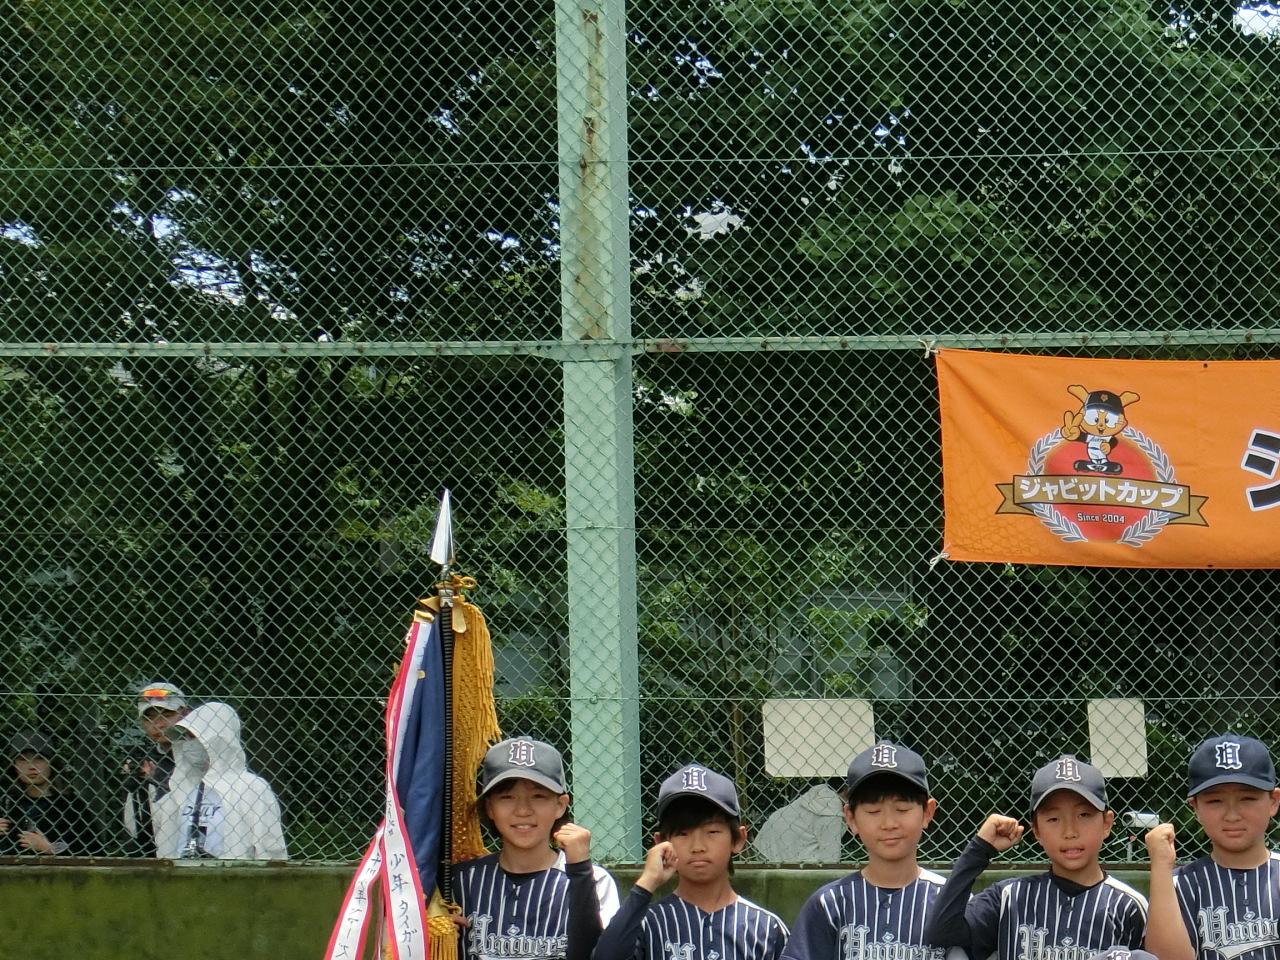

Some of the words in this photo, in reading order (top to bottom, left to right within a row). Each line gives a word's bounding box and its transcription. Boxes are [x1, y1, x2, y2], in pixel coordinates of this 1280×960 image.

[1019, 478, 1184, 508] ジャビットカップ
[1077, 513, 1099, 522] Since
[1102, 513, 1126, 523] 2004
